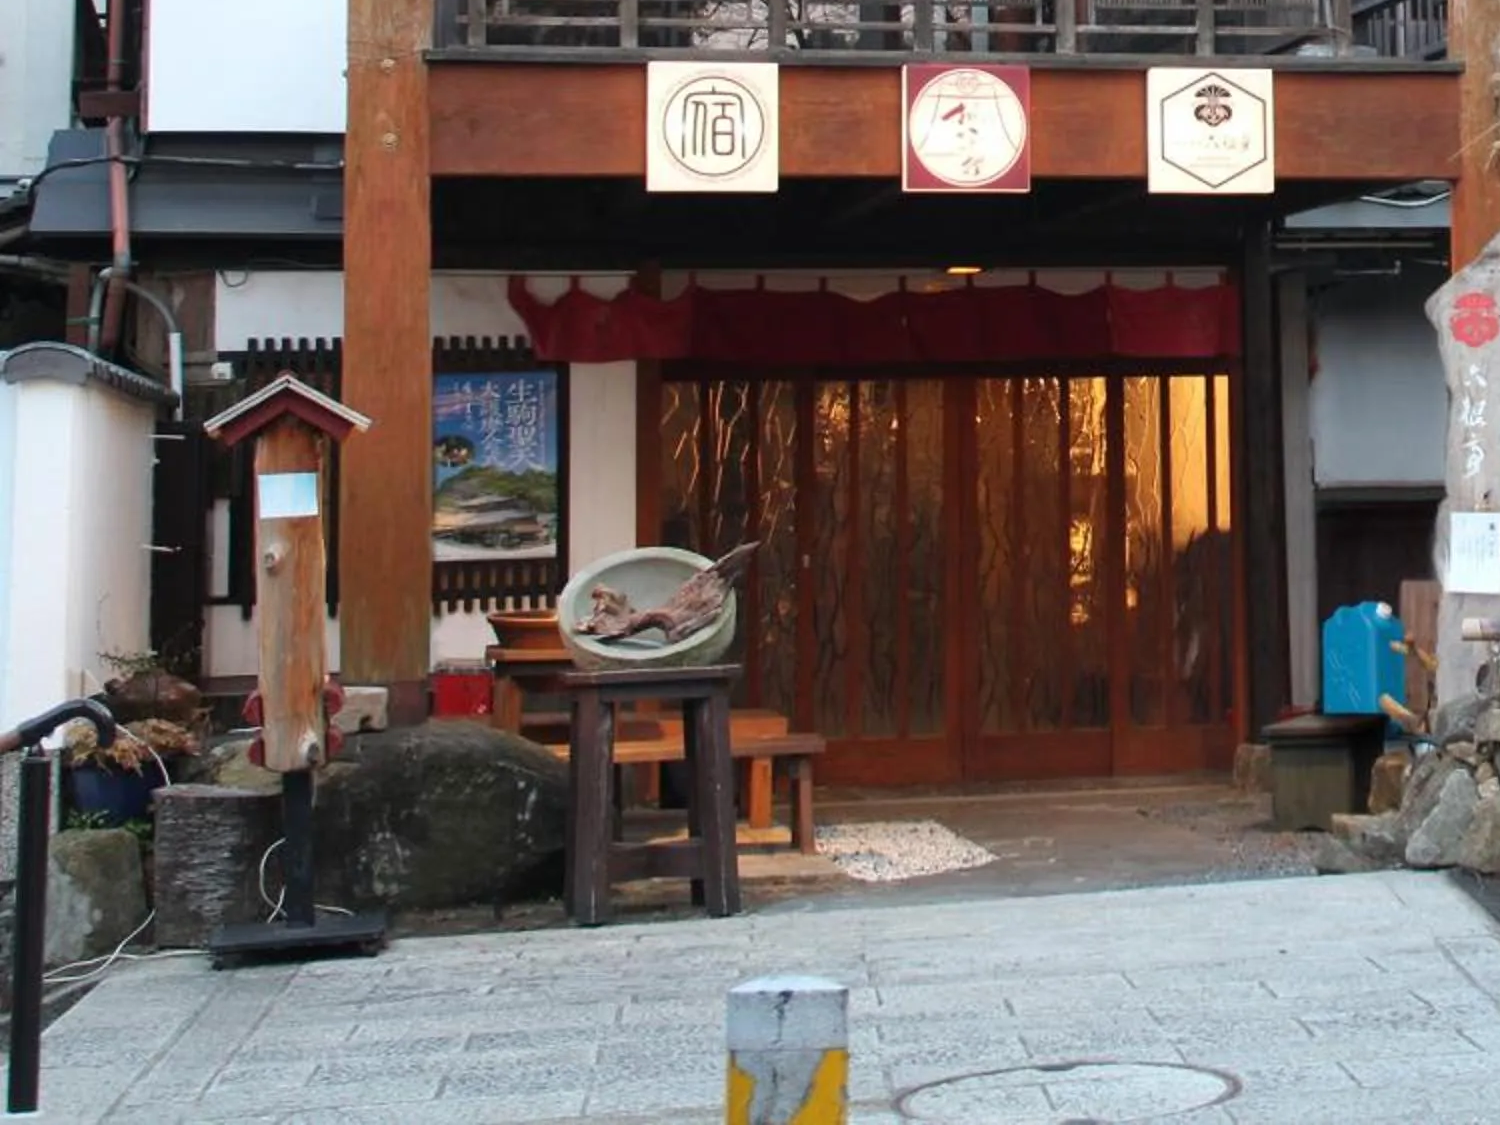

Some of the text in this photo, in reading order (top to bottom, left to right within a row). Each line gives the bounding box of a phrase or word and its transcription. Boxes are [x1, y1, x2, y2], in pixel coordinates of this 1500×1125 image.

[680, 84, 747, 160] 宿
[504, 378, 541, 469] 生駒聖天
